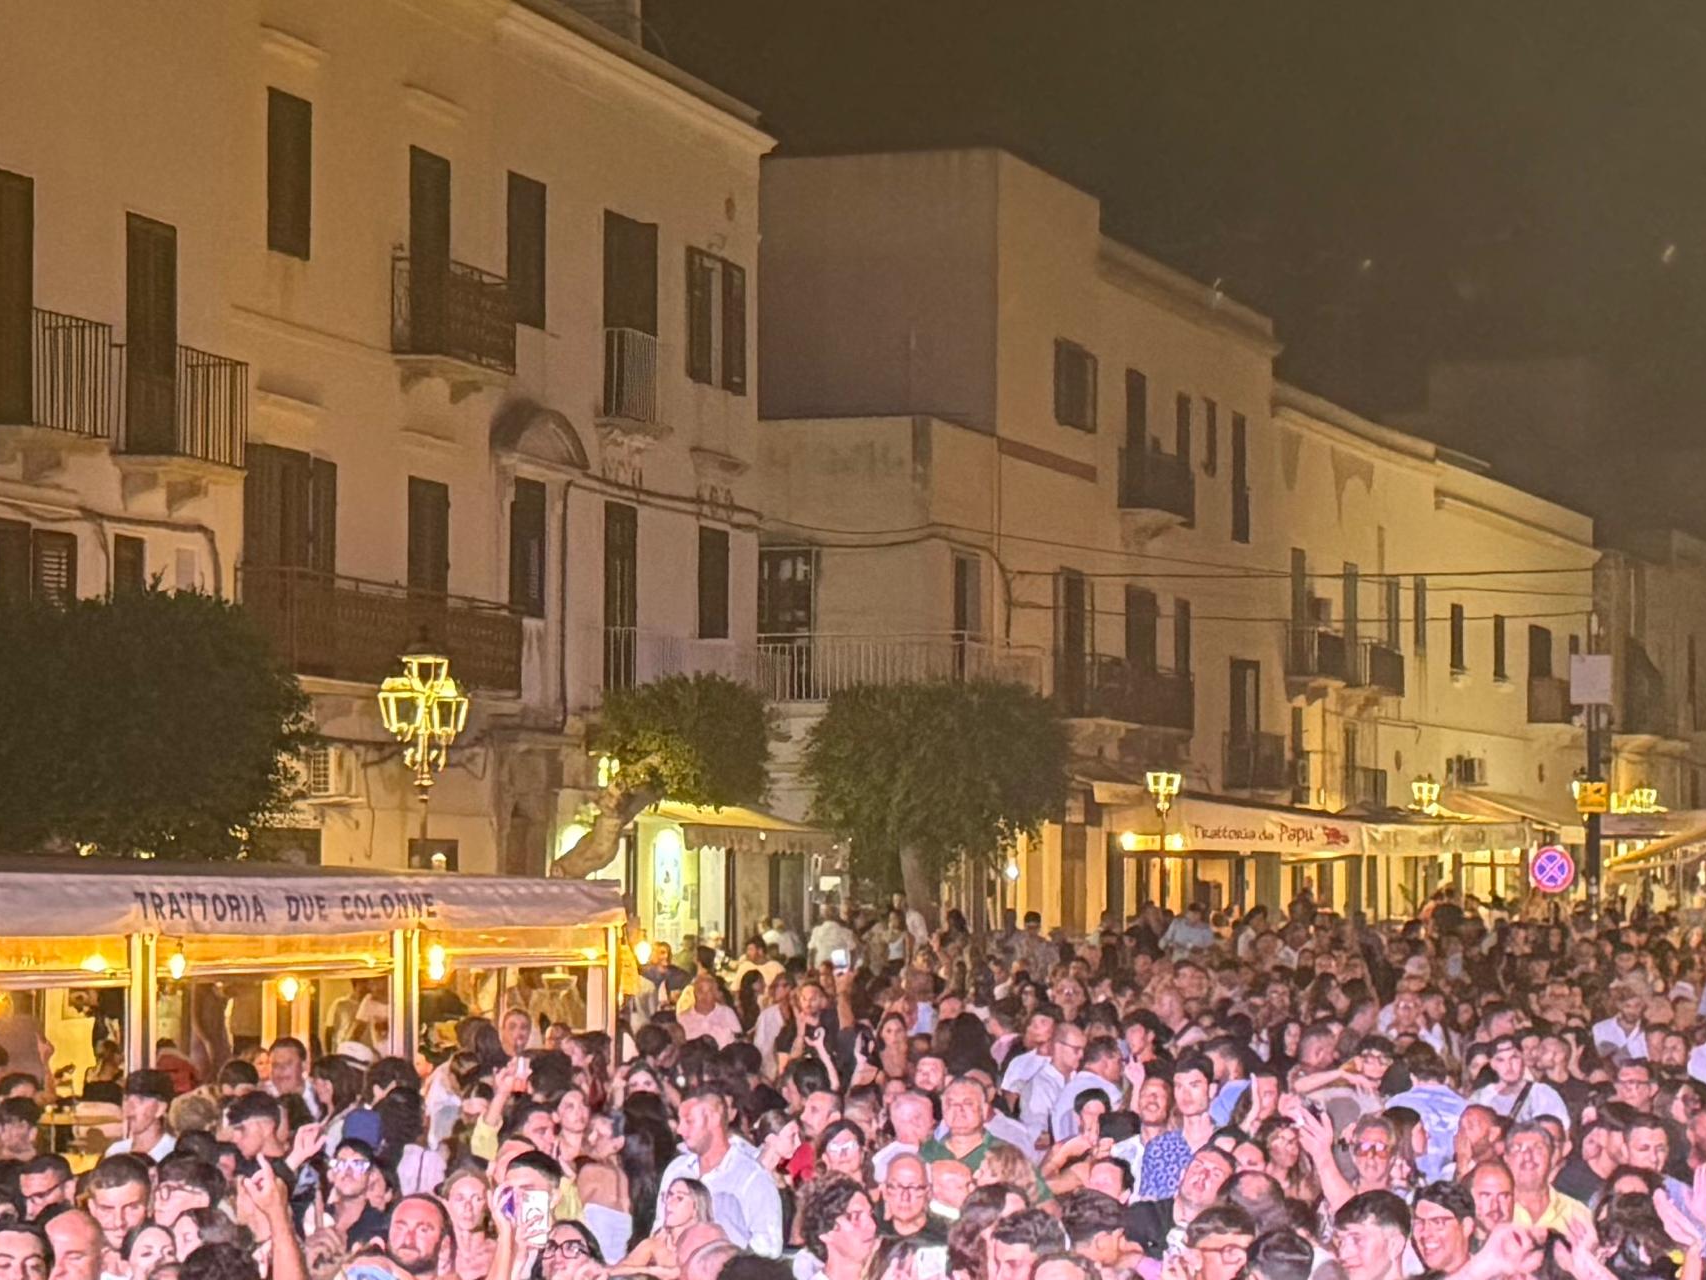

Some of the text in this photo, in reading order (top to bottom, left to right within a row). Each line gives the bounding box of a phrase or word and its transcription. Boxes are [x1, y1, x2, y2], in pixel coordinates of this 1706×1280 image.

[133, 891, 438, 923] TRATTORIA DUE COLONNE
